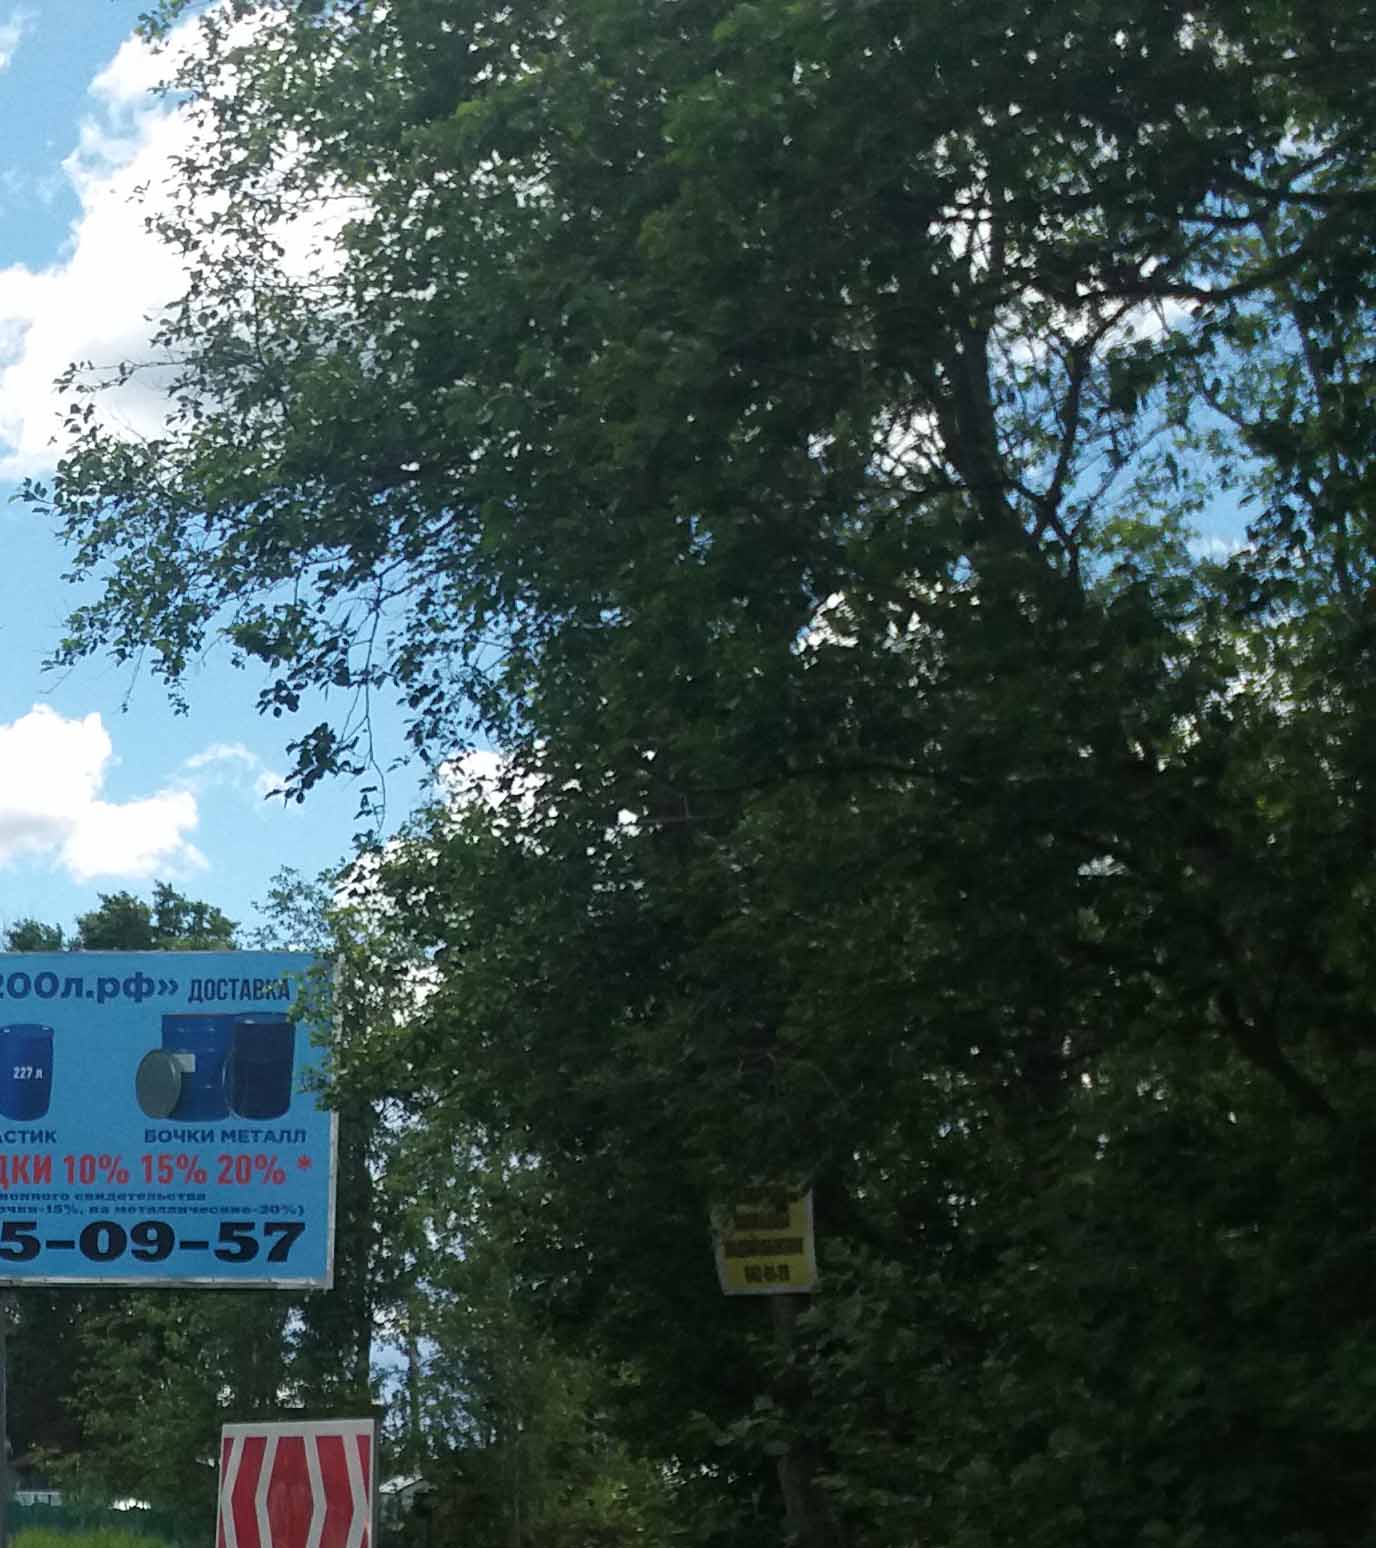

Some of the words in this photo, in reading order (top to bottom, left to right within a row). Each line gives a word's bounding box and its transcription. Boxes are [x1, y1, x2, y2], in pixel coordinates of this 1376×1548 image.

[187, 977, 290, 1002] ДОСТАВКА
[13, 1066, 33, 1080] 227
[144, 1129, 214, 1144] БОЧКИ
[221, 1129, 307, 1144] МЕТАЛЛ
[63, 1154, 129, 1185] 10%
[142, 1154, 207, 1185] 15%
[217, 1154, 286, 1185] 20%
